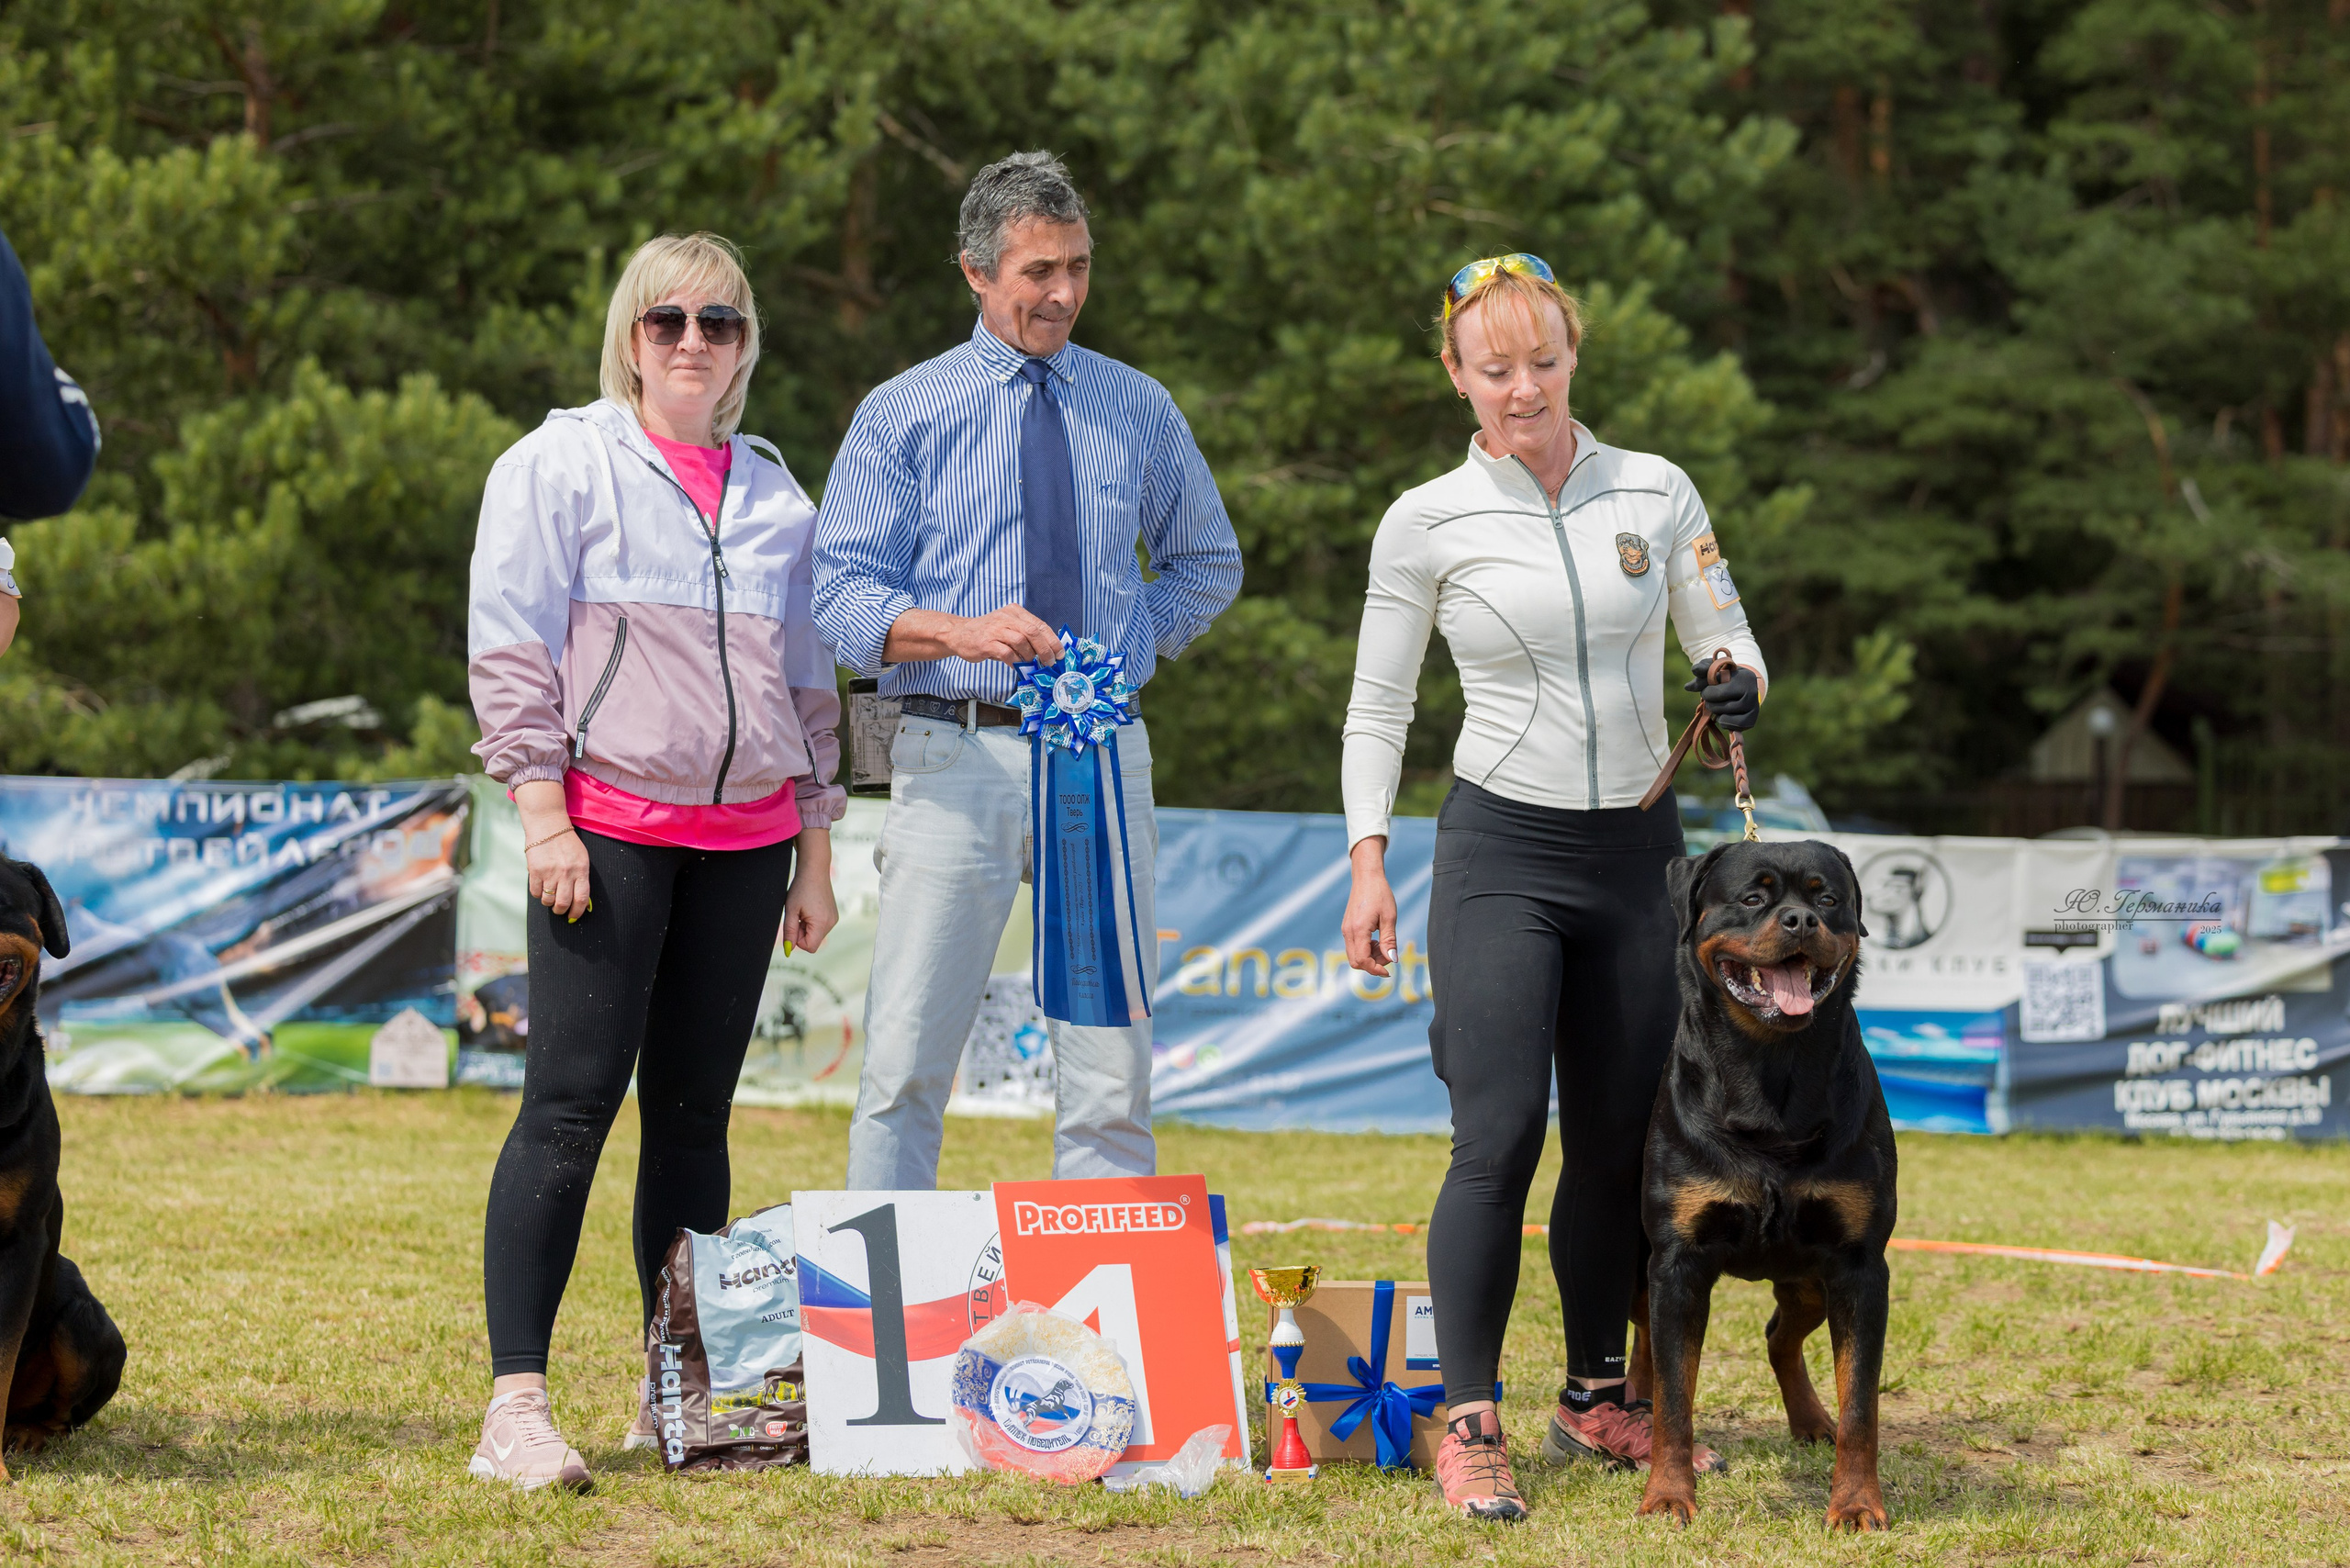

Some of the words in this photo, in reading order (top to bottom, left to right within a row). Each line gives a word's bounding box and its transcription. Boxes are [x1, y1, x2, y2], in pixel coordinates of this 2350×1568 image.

[68, 790, 393, 826] ЧЕМПИОНАТ
[1066, 806, 1083, 819] Тверь
[2155, 994, 2286, 1036] ЛУЧШИЙ
[2125, 1037, 2320, 1077] ДОГ-ФИТНЕС
[2113, 1079, 2194, 1113] КЛУБ
[2195, 1074, 2332, 1109] МОСКВЫ
[1014, 1201, 1186, 1236] PROFIFEED
[719, 1256, 796, 1291] Hant
[752, 1277, 790, 1294] premium
[760, 1308, 796, 1324] ADULT
[827, 1203, 946, 1426] 1
[649, 1381, 658, 1429] premium
[659, 1344, 686, 1463] Hanta
[1027, 1434, 1072, 1450] ПОБЕДИТЕЛЬ
